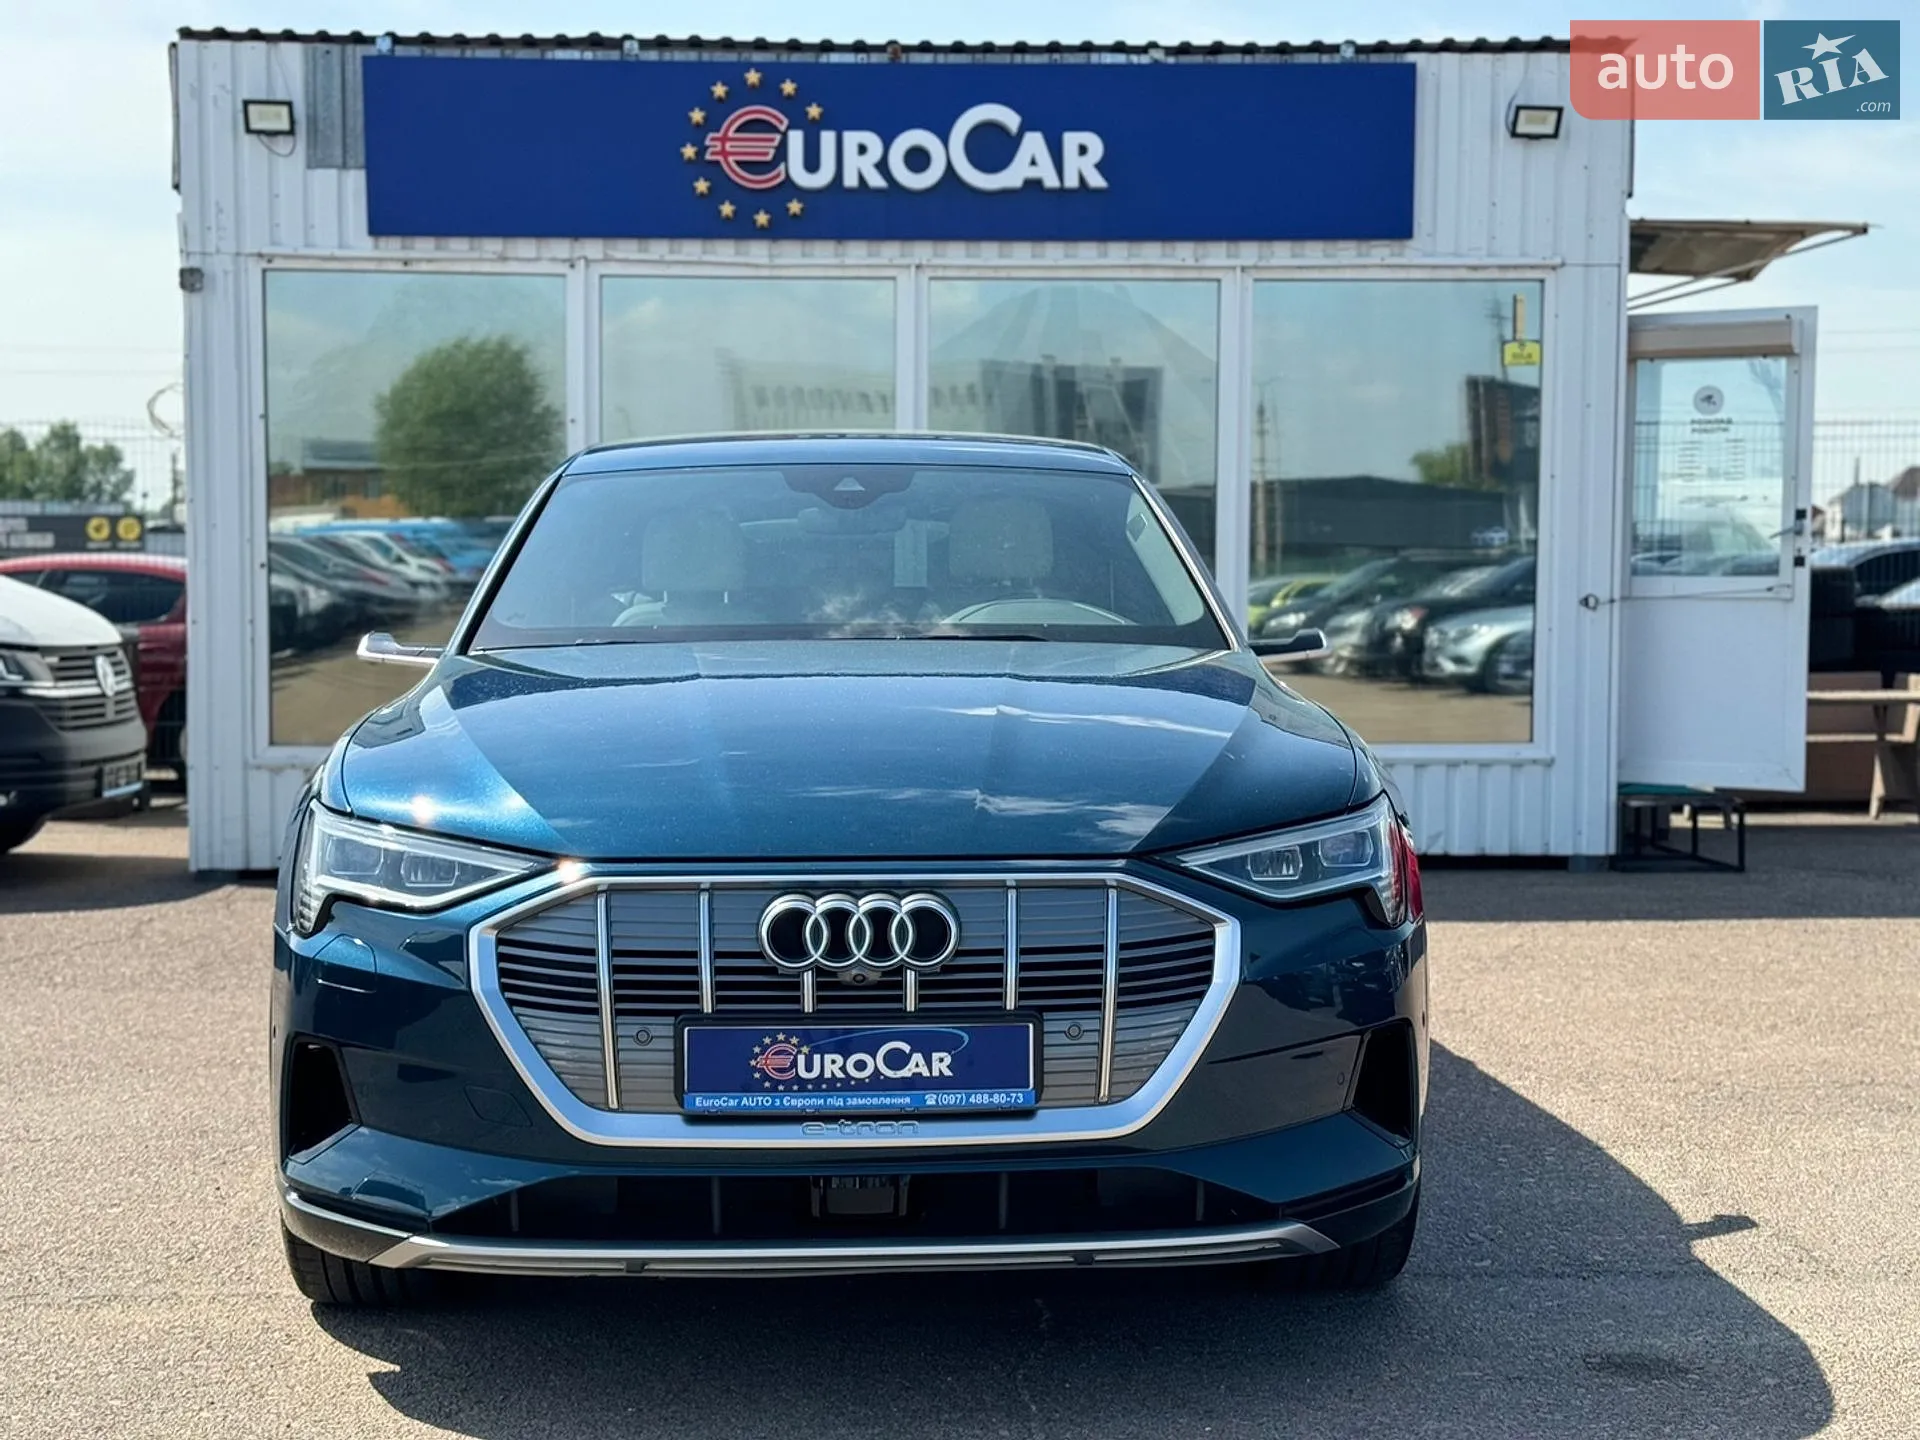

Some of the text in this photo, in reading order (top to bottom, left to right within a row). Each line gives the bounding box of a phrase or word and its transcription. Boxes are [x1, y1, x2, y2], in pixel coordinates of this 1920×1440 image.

[695, 1096, 738, 1107] EuroCar
[741, 1096, 772, 1107] AUTO
[783, 1096, 824, 1109] Європи
[826, 1095, 844, 1108] під
[846, 1097, 911, 1107] замовлення
[937, 1092, 1024, 1106] (097) 488-80-73
[801, 1119, 920, 1136] e-tron
